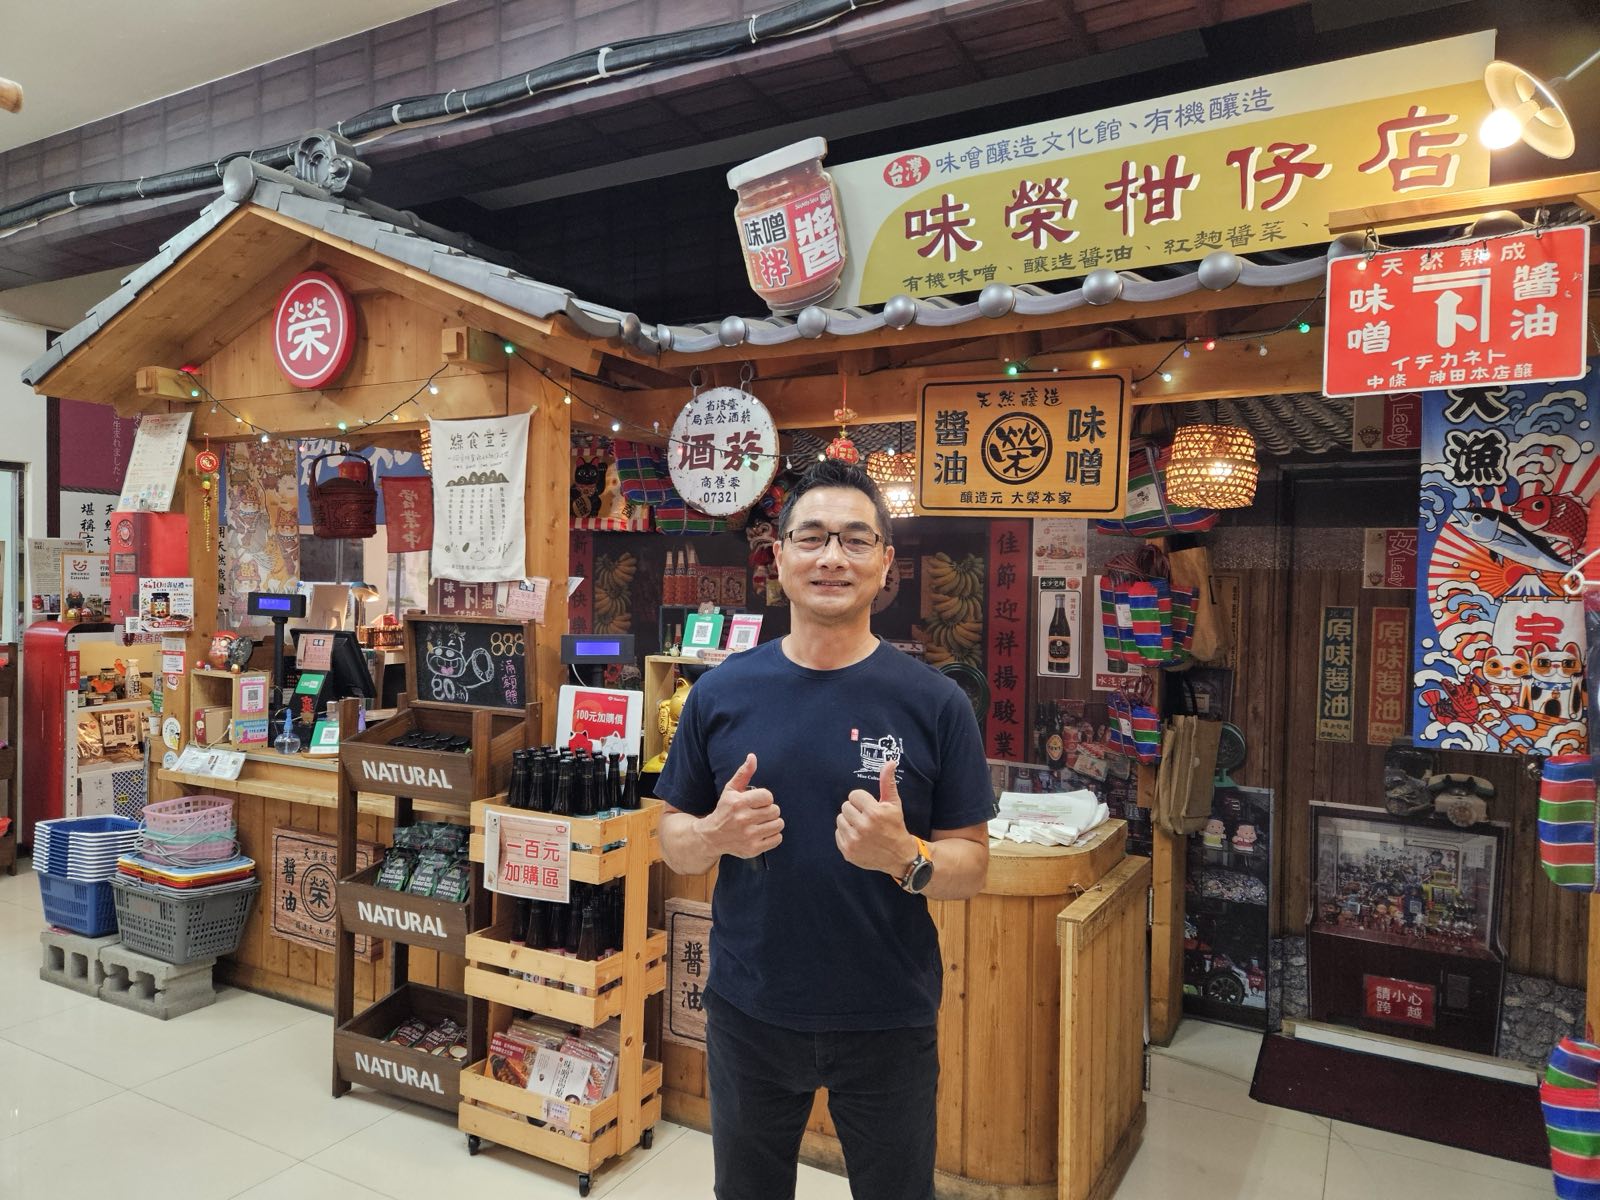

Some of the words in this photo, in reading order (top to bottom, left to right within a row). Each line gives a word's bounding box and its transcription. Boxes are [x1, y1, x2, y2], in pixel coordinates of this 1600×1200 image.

[886, 156, 929, 188] 台灣
[904, 104, 1470, 263] 味榮柑仔店
[744, 212, 787, 246] 味噌
[794, 205, 840, 278] 醬
[1381, 242, 1526, 277] 天然熟成
[1347, 283, 1395, 355] 味噌
[1510, 262, 1560, 341] 醬油
[288, 297, 331, 361] 榮
[1391, 350, 1506, 372] イチカネト
[1387, 403, 1414, 447] Lady
[933, 410, 970, 485] 醬油
[1065, 405, 1107, 486] 味噌
[703, 491, 737, 503] 07321
[1011, 491, 1073, 504] 大榮本家
[81, 502, 96, 553] 堪稱京
[1388, 532, 1417, 556] 女
[1388, 558, 1406, 586] Lady
[1324, 618, 1352, 717] 原味醬油
[576, 709, 624, 726] 100元加購價
[361, 760, 453, 790] NATURAL
[506, 839, 560, 862] 一百元
[282, 857, 297, 913] 醬油
[309, 876, 331, 909] 榮
[504, 863, 560, 888] 加購區
[358, 901, 448, 938] NATURAL
[681, 941, 704, 1012] 醬油
[1375, 985, 1424, 1006] 請小心
[1376, 1000, 1392, 1014] 跨
[1407, 1006, 1423, 1020] 越
[355, 1052, 445, 1095] NATURAL
